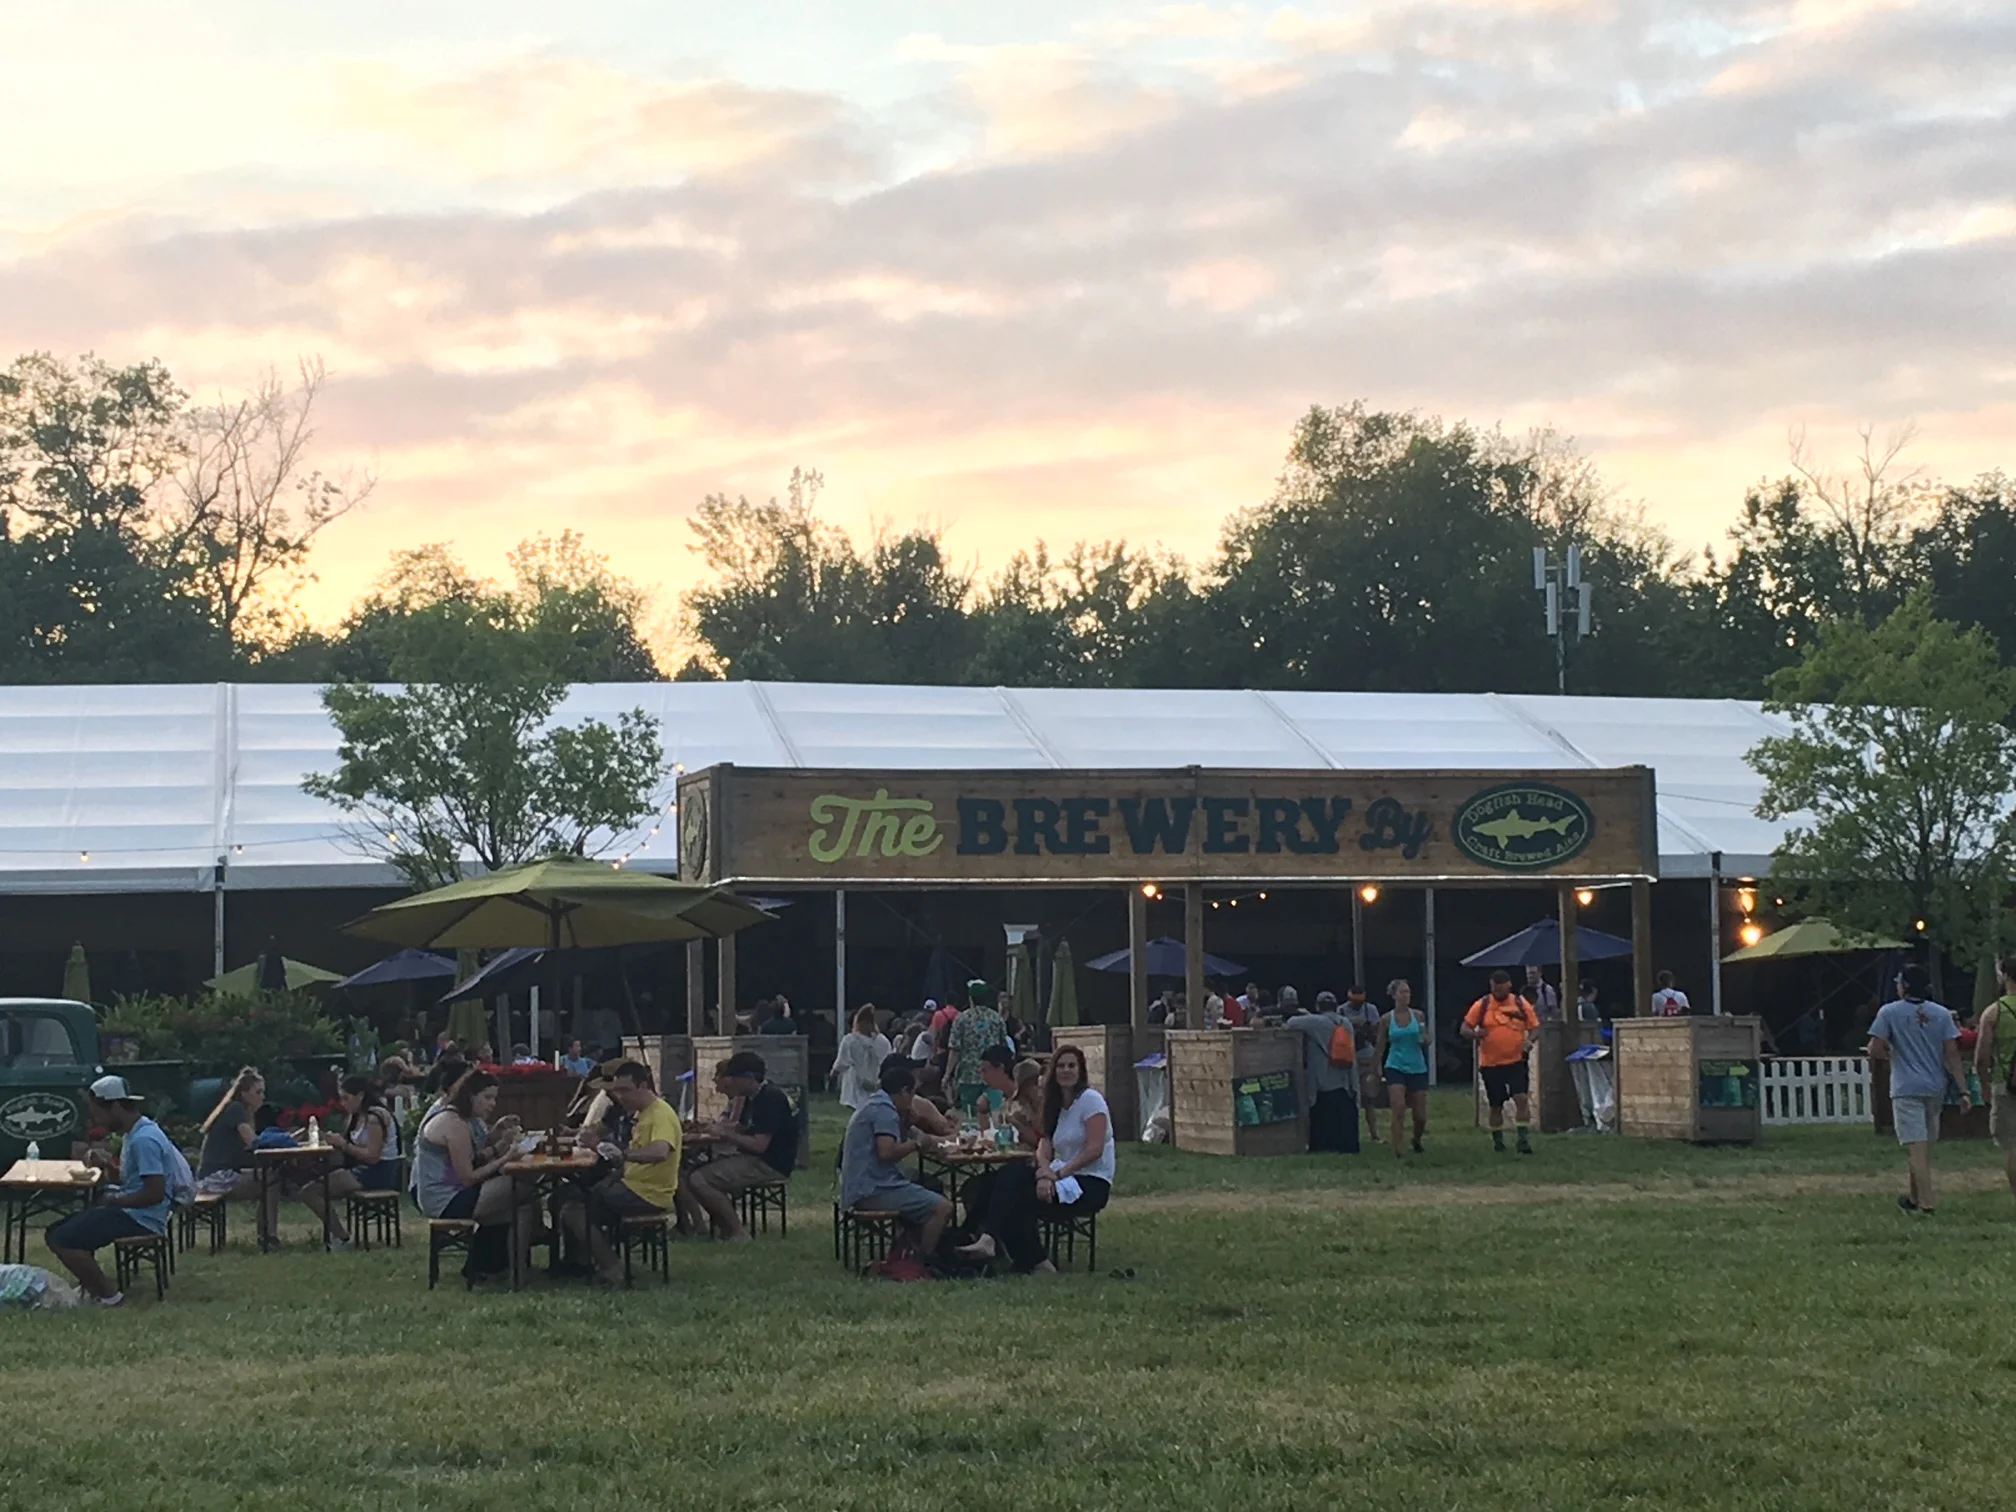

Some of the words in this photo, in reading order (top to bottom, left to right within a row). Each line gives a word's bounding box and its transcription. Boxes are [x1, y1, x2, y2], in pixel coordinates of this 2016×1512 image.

[1468, 793, 1521, 823] Dogfish
[1526, 793, 1563, 810] Head
[809, 788, 944, 863] The
[956, 797, 1353, 855] BREWERY
[1360, 795, 1434, 861] By
[1467, 836, 1500, 859] Craft
[1504, 848, 1552, 861] Brewed
[1556, 831, 1580, 853] Ales
